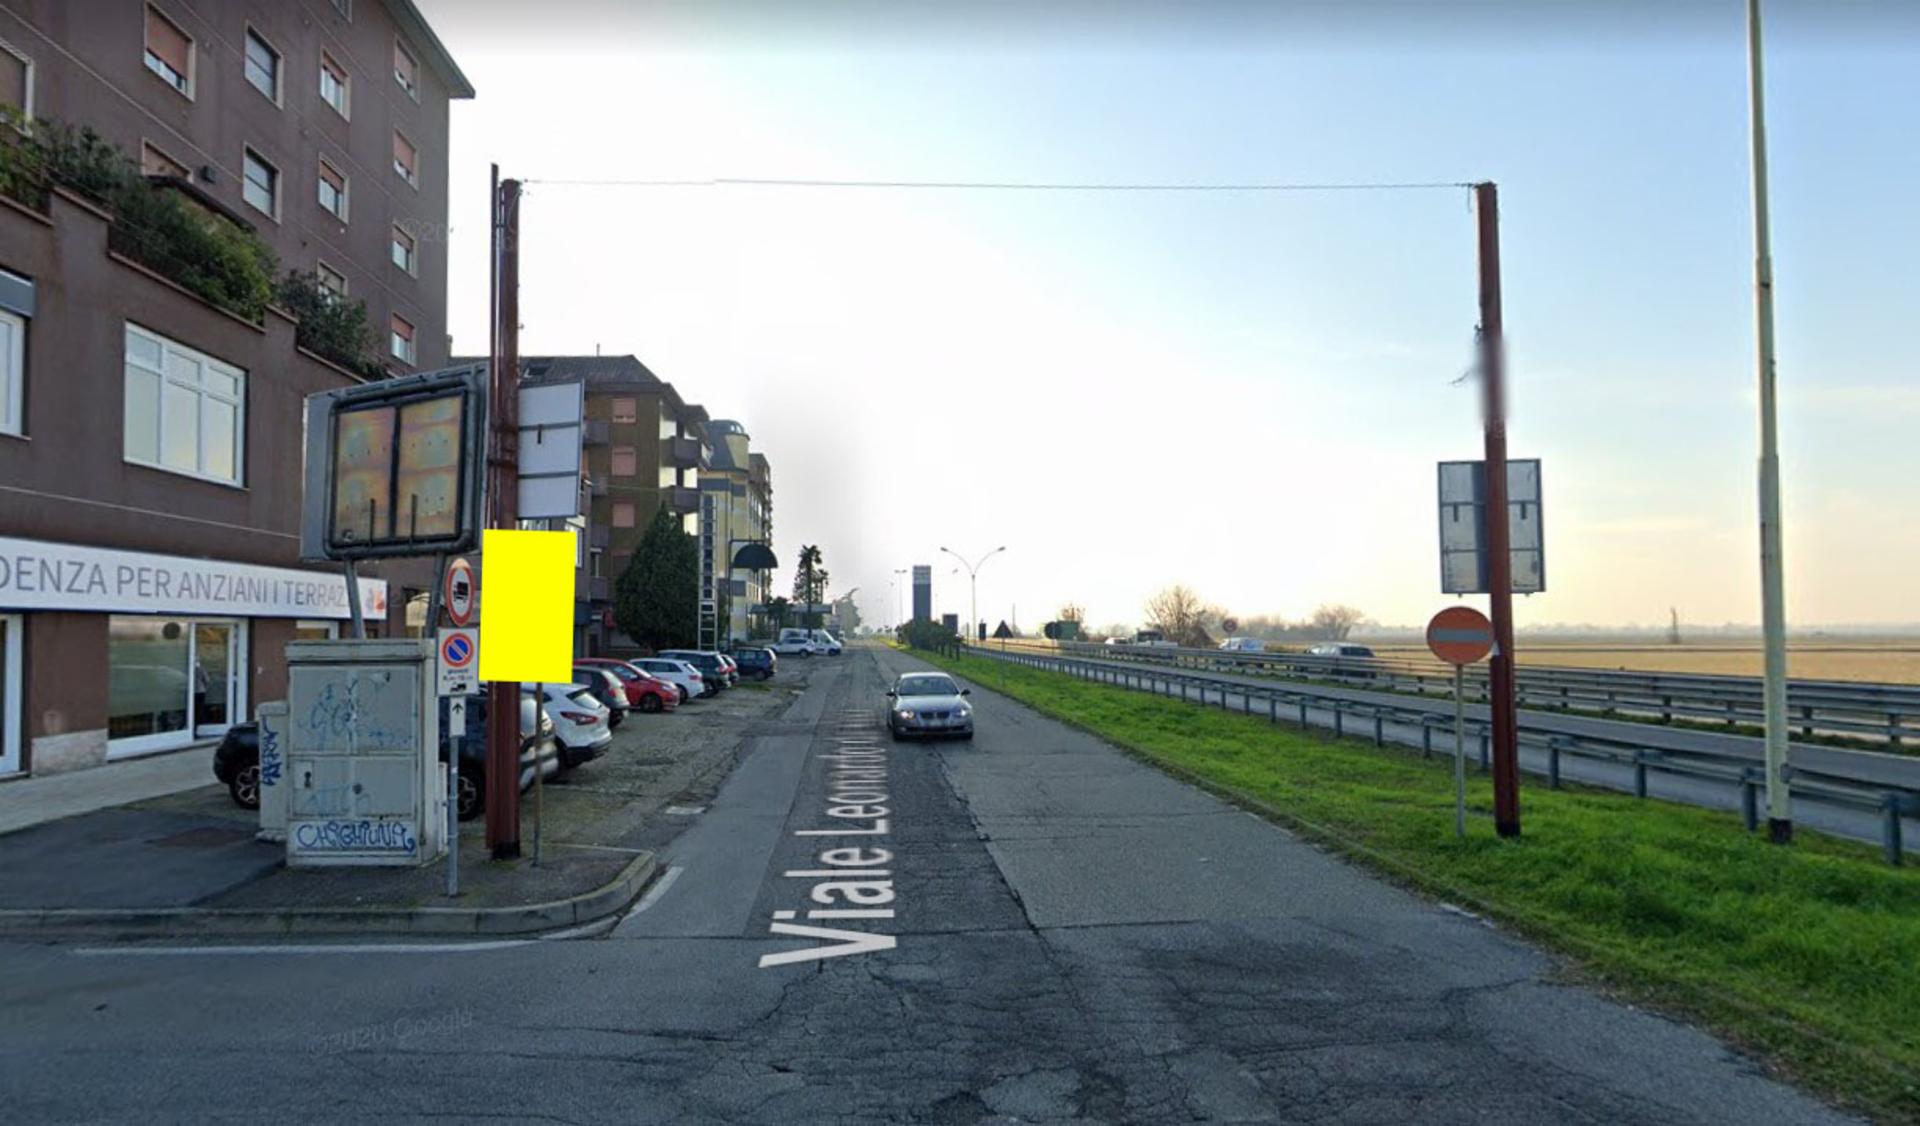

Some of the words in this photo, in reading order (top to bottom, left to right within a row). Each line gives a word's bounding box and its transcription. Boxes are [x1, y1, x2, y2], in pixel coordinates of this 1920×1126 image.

[117, 565, 171, 598] PER
[177, 571, 268, 604] ANZIANI
[273, 581, 279, 605] I
